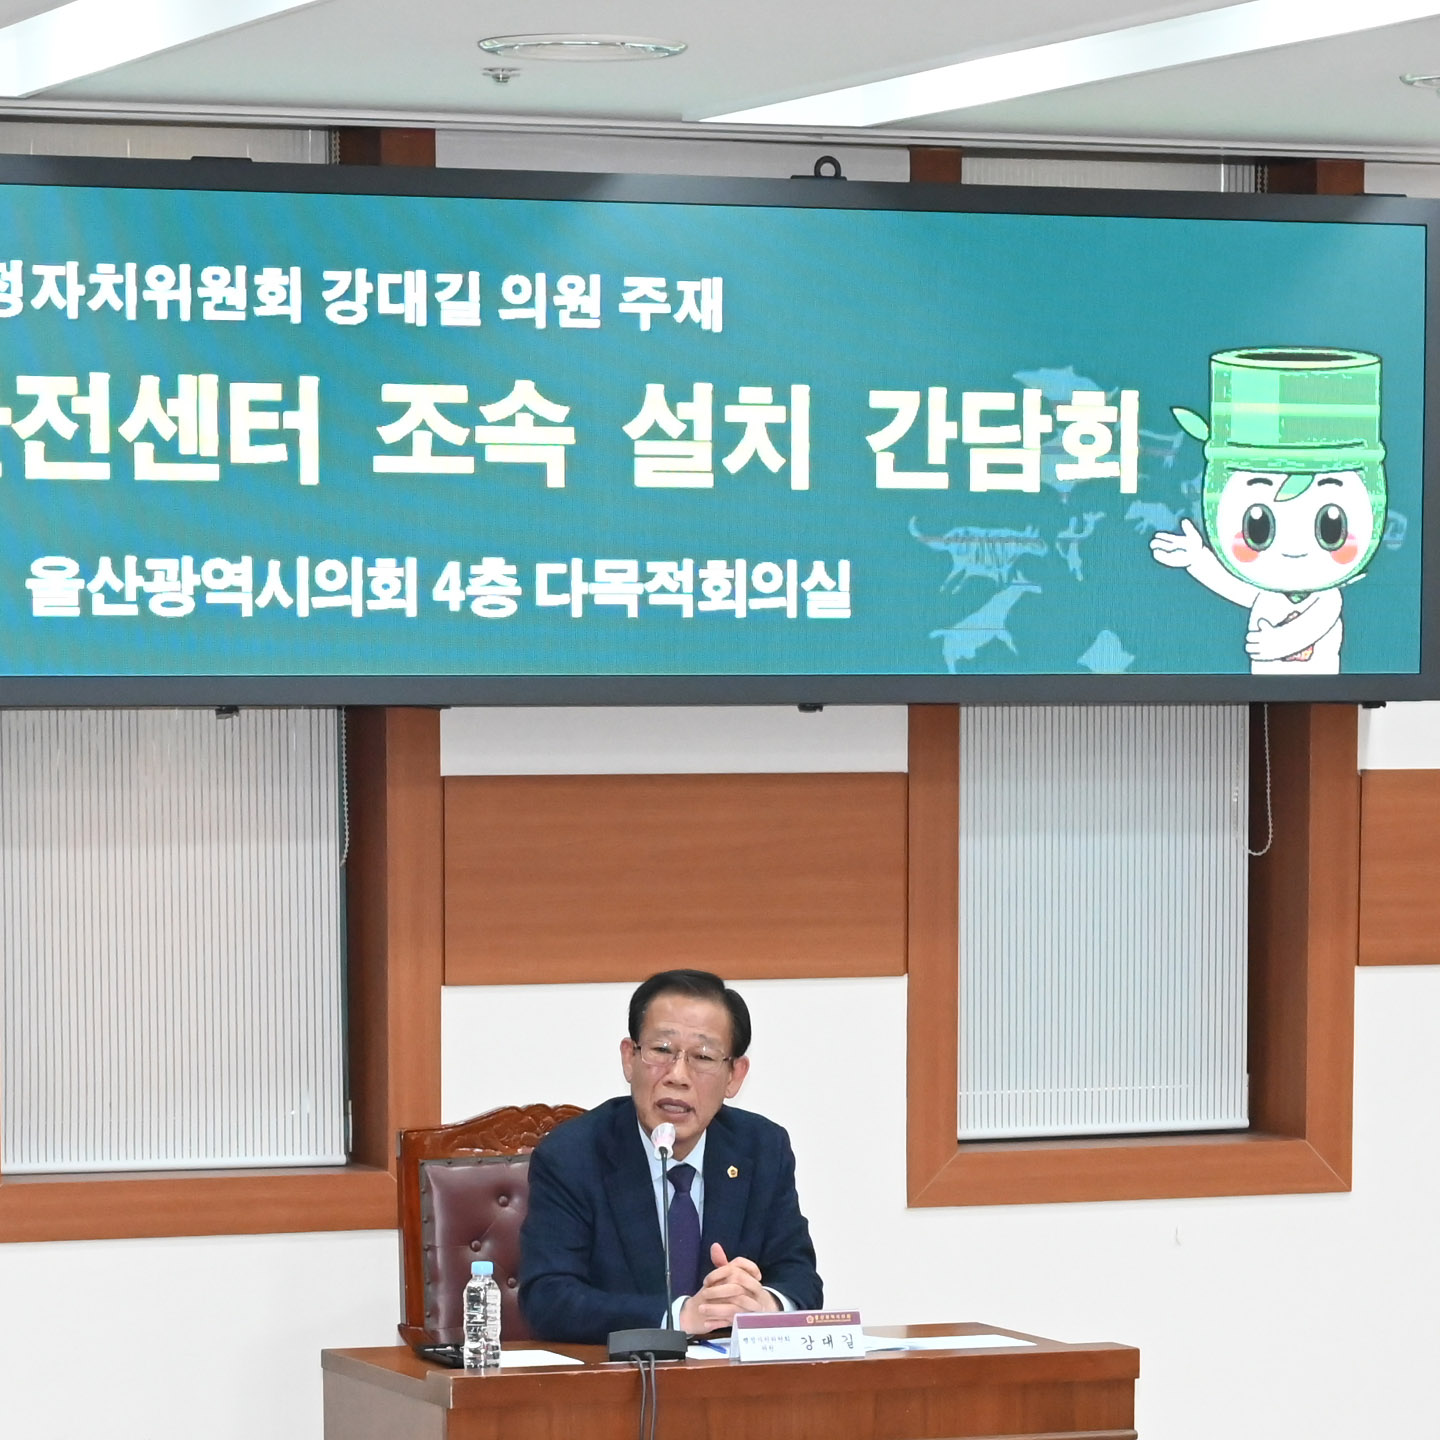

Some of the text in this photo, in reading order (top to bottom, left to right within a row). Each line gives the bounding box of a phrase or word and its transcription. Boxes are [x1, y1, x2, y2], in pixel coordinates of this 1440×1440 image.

[322, 268, 481, 328] 강대길
[498, 272, 601, 329] 의원
[618, 276, 723, 332] 주재
[373, 379, 576, 488] 조속
[622, 382, 811, 491] 설치
[866, 386, 1139, 494] 간담회
[25, 555, 852, 620] 울산광역시의회 4층 다목적회의실
